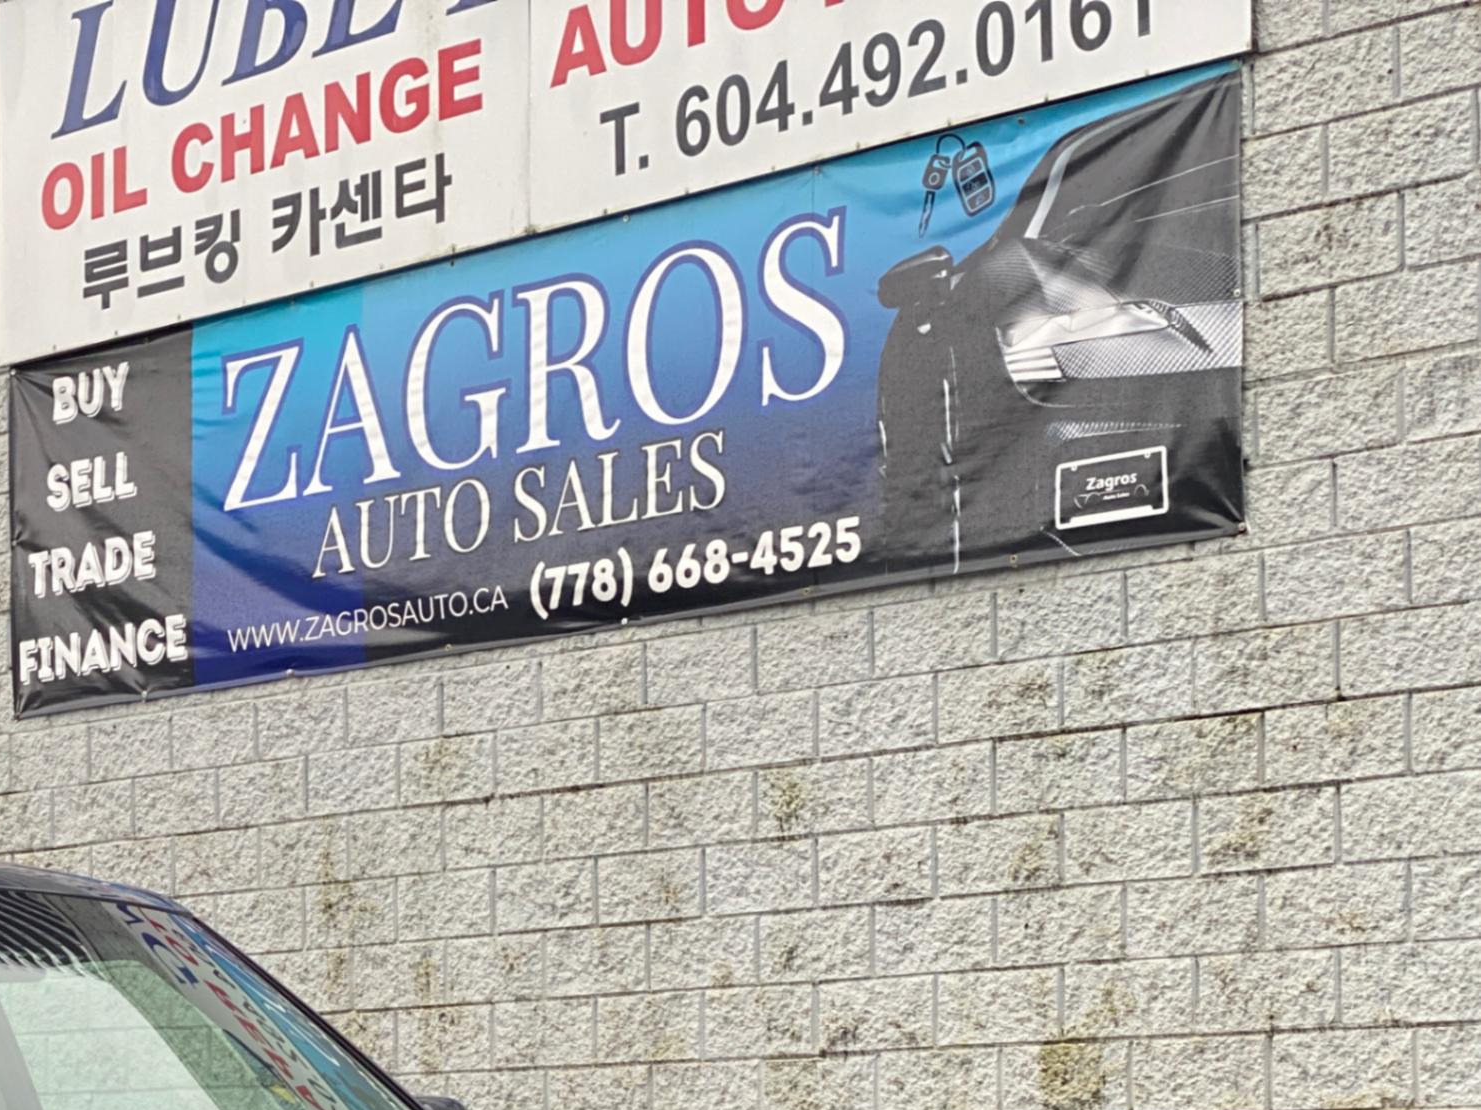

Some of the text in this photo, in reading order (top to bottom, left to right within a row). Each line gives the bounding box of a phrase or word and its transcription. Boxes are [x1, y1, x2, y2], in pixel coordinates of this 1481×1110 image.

[42, 38, 484, 230] OIL CHANGE
[599, 103, 649, 176] T.
[82, 153, 453, 310] 루브킹 카센타
[51, 361, 129, 424] BUY
[222, 206, 847, 513] ZAGROS
[46, 451, 137, 512] SELL
[312, 431, 726, 578] AUTO SALES
[1085, 472, 1138, 492] Zagros
[28, 530, 156, 598] TRADE
[226, 516, 863, 653] WWW.ZAGROSAUTO.CA (778) 668-4525
[19, 613, 188, 685] FINANCE
